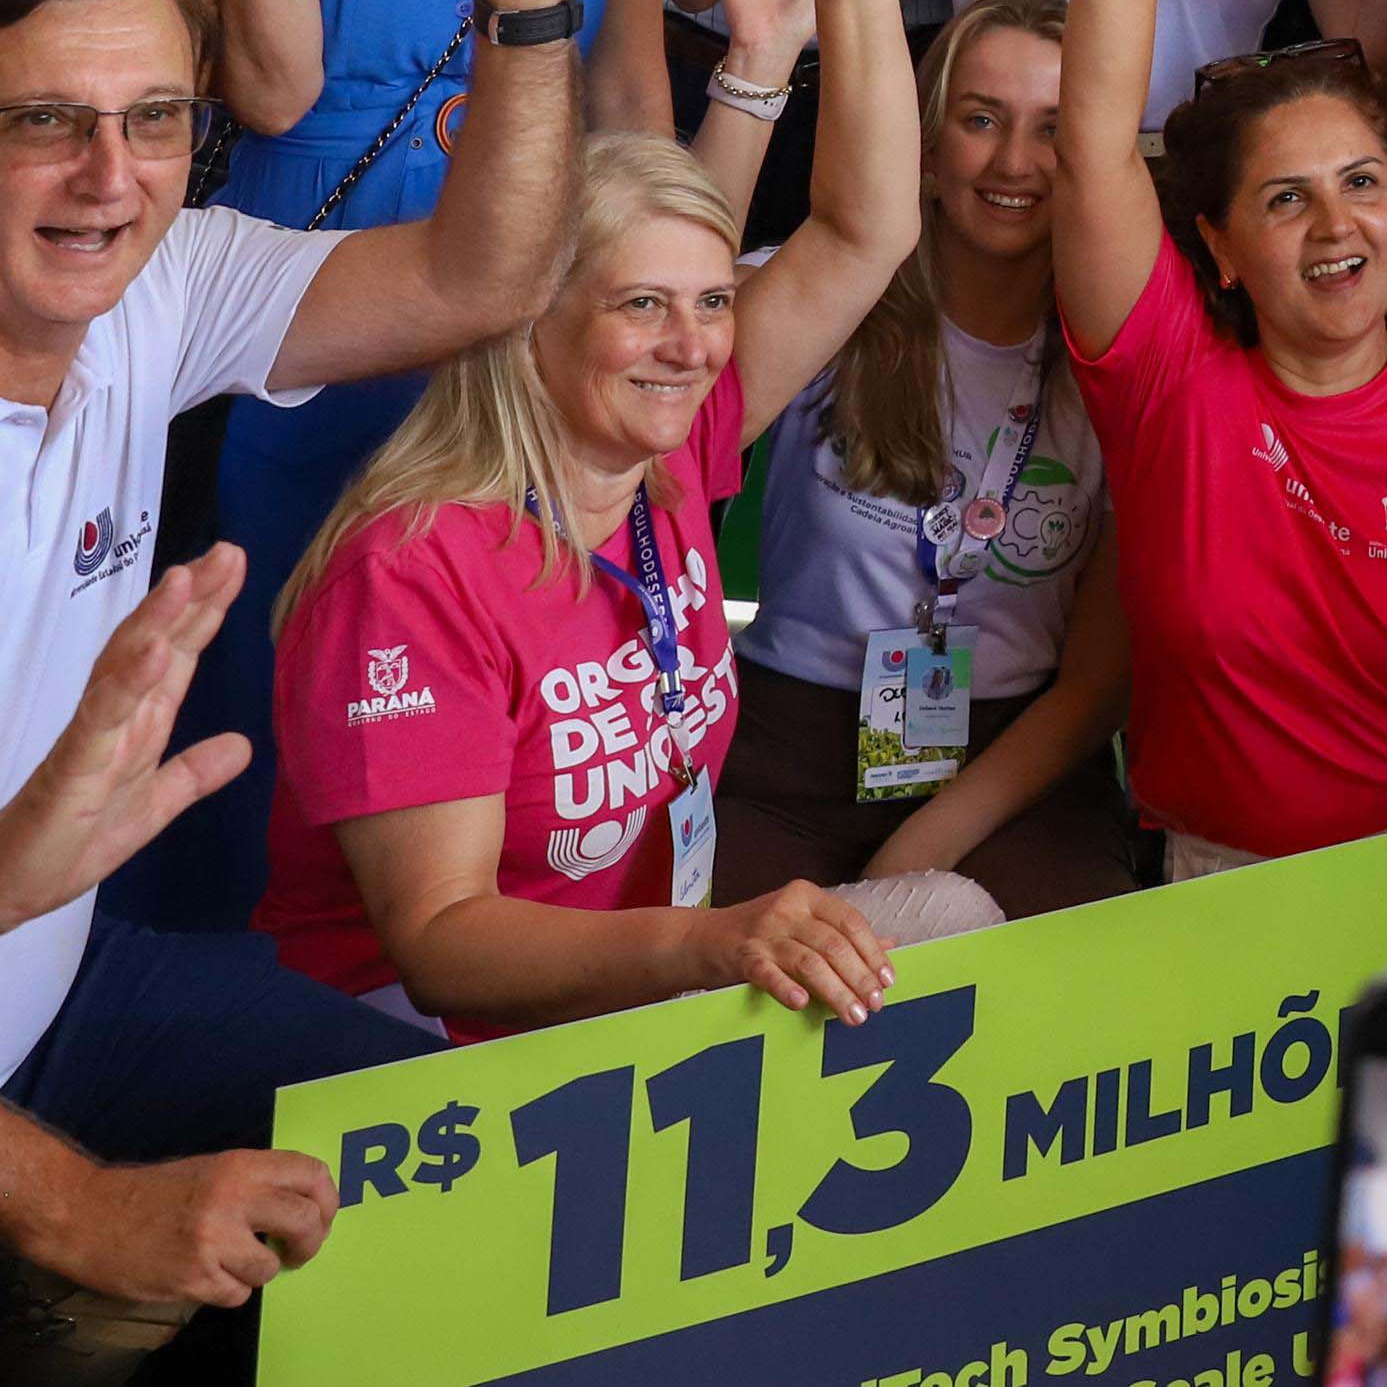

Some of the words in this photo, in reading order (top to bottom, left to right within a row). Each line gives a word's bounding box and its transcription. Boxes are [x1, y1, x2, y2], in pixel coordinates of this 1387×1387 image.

[850, 505, 882, 526] Cadeia
[883, 518, 919, 537] Agroal
[347, 686, 436, 719] PARANÁ
[549, 702, 639, 770] DE
[554, 638, 739, 821] UNIOEST
[338, 1101, 482, 1209] R$
[508, 984, 977, 1318] 11,3
[1001, 989, 1346, 1183] MILHÕ
[1045, 1250, 1326, 1377] Symbiosi
